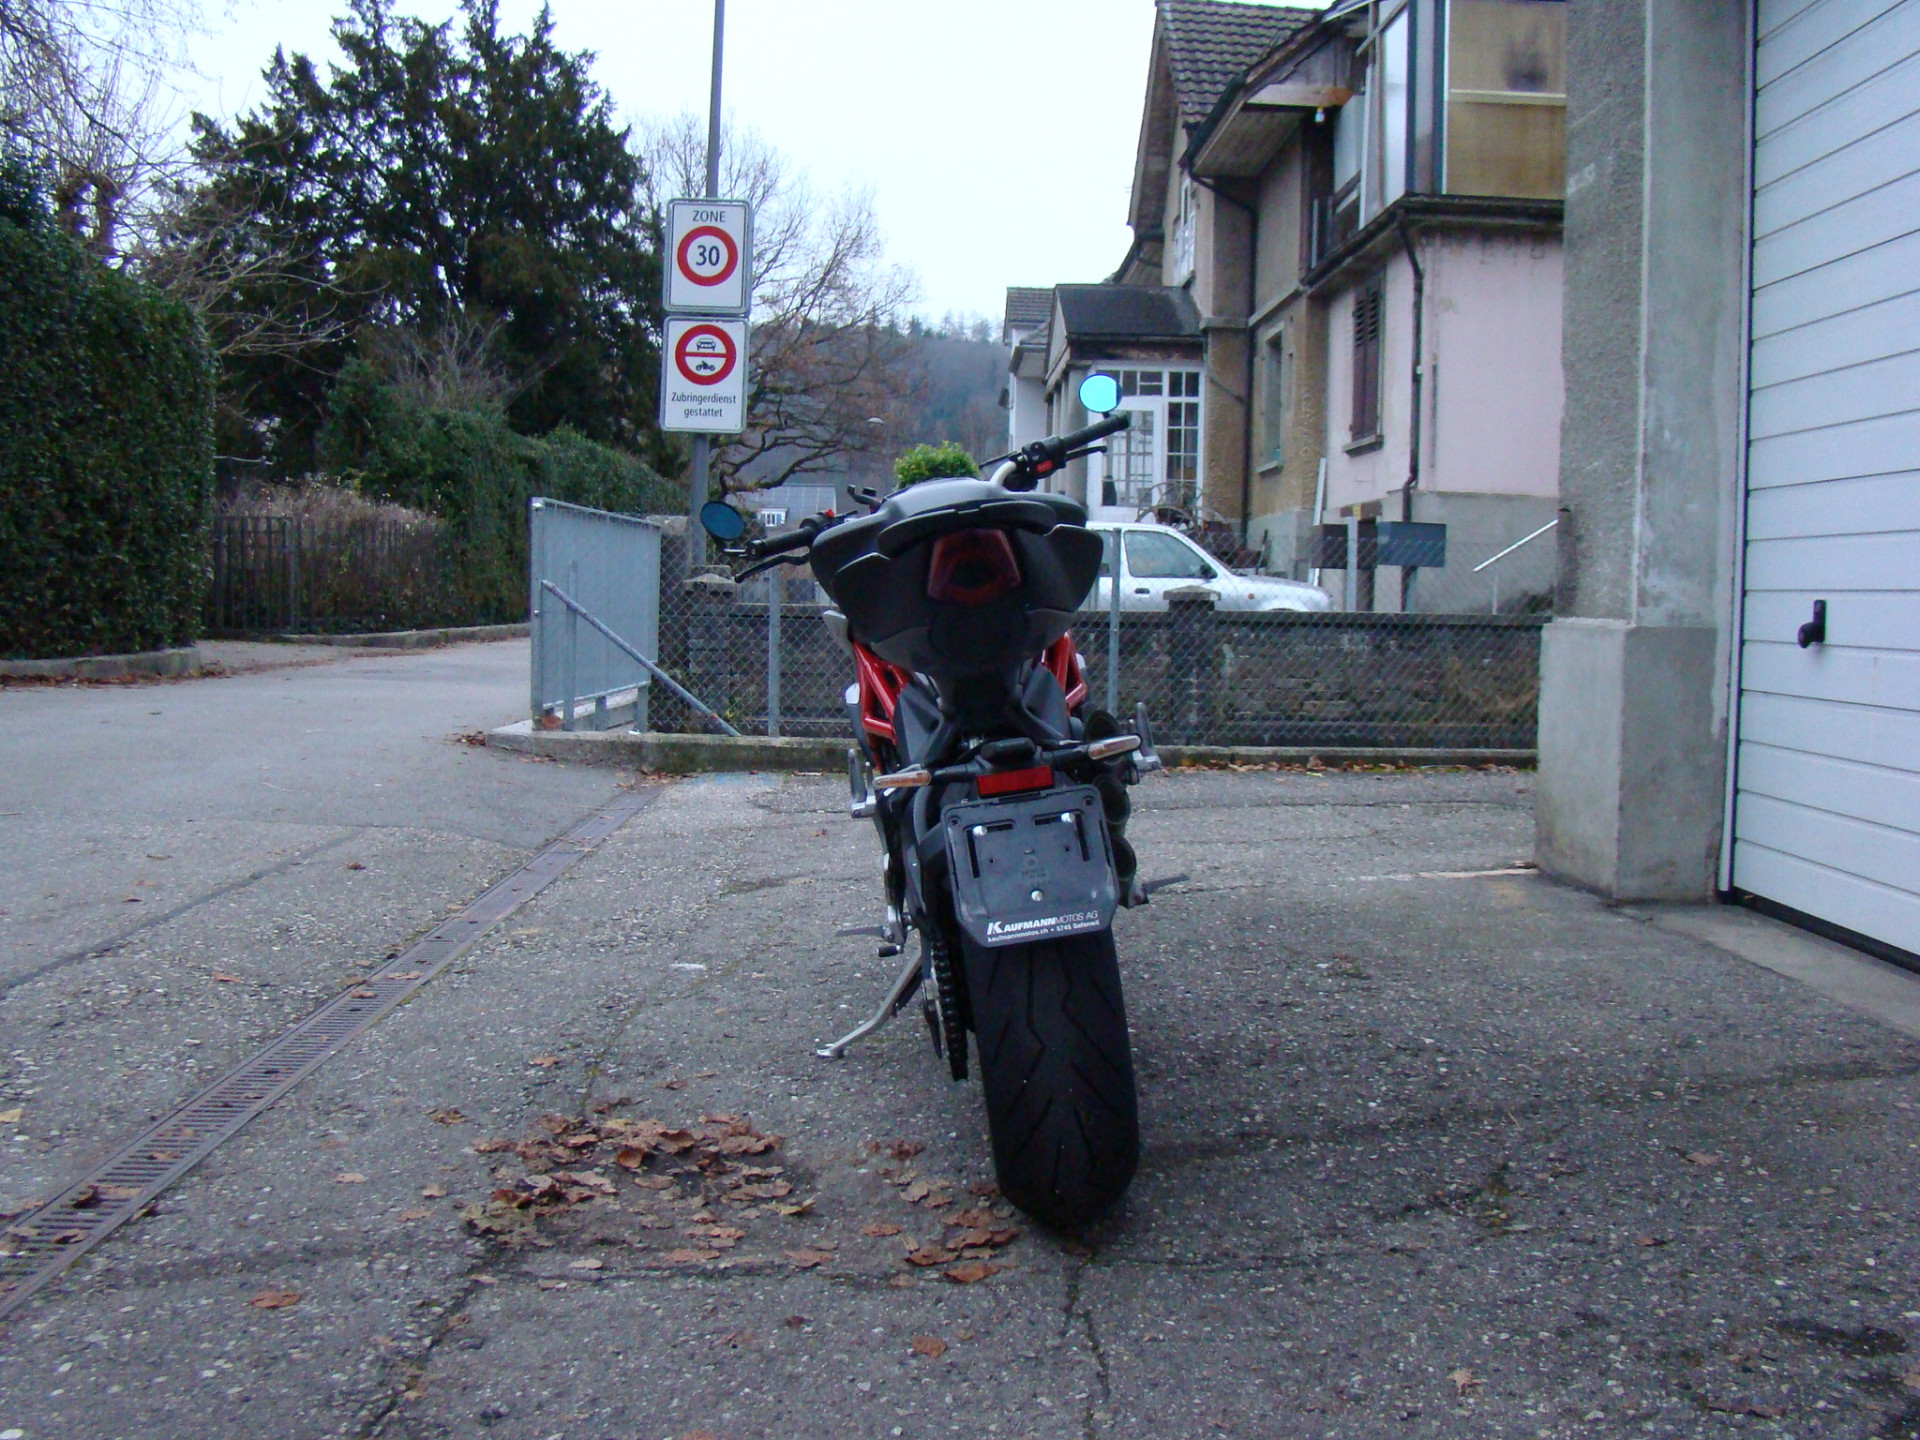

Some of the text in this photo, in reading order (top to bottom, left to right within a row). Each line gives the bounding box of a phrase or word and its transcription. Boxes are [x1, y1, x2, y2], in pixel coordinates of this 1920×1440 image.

[692, 210, 726, 223] ZONE
[695, 245, 720, 266] 30
[671, 392, 736, 405] Zubringerdienst
[683, 408, 722, 418] gestattet
[1086, 910, 1098, 919] AG
